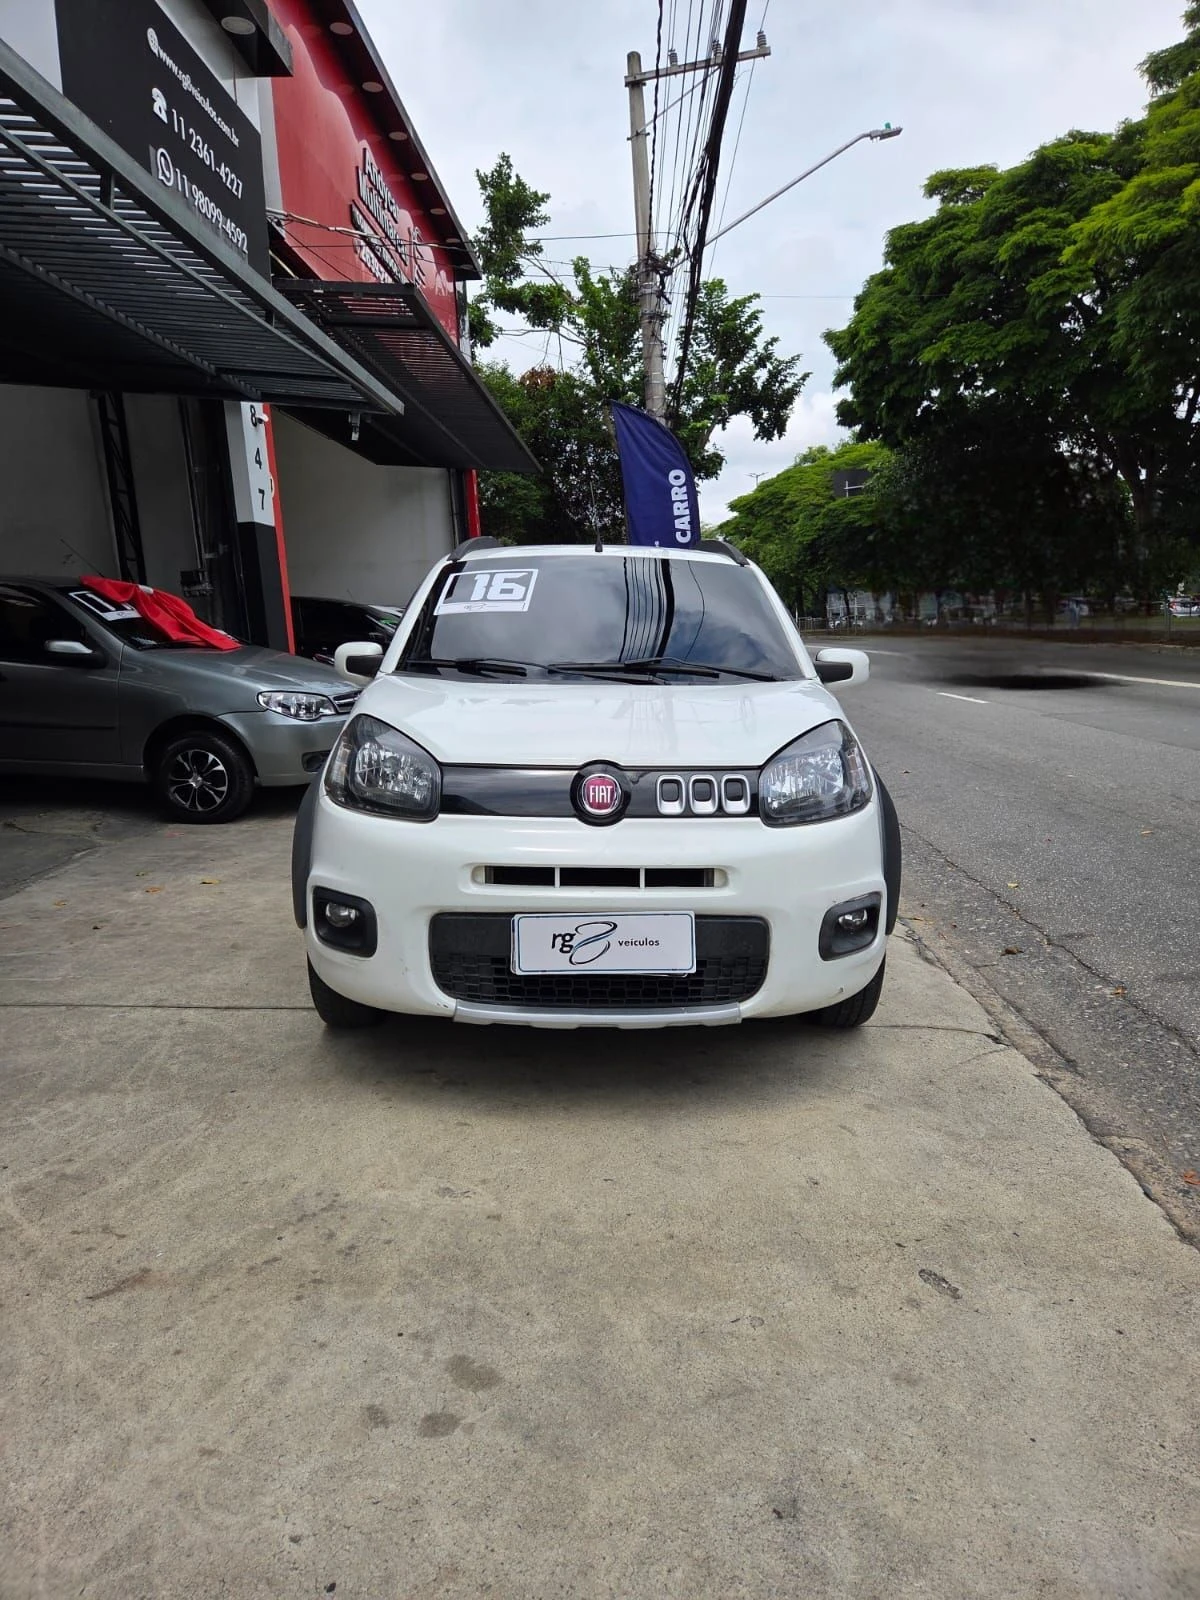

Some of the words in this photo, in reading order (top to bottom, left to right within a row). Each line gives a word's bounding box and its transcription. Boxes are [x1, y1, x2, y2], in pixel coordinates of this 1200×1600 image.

[171, 108, 186, 140] 11
[189, 127, 243, 199] 2361-4227
[175, 168, 189, 198] 11
[192, 184, 249, 254] 98099-4592
[668, 469, 692, 544] CARRO
[470, 572, 529, 601] 16
[589, 785, 613, 804] FIAT
